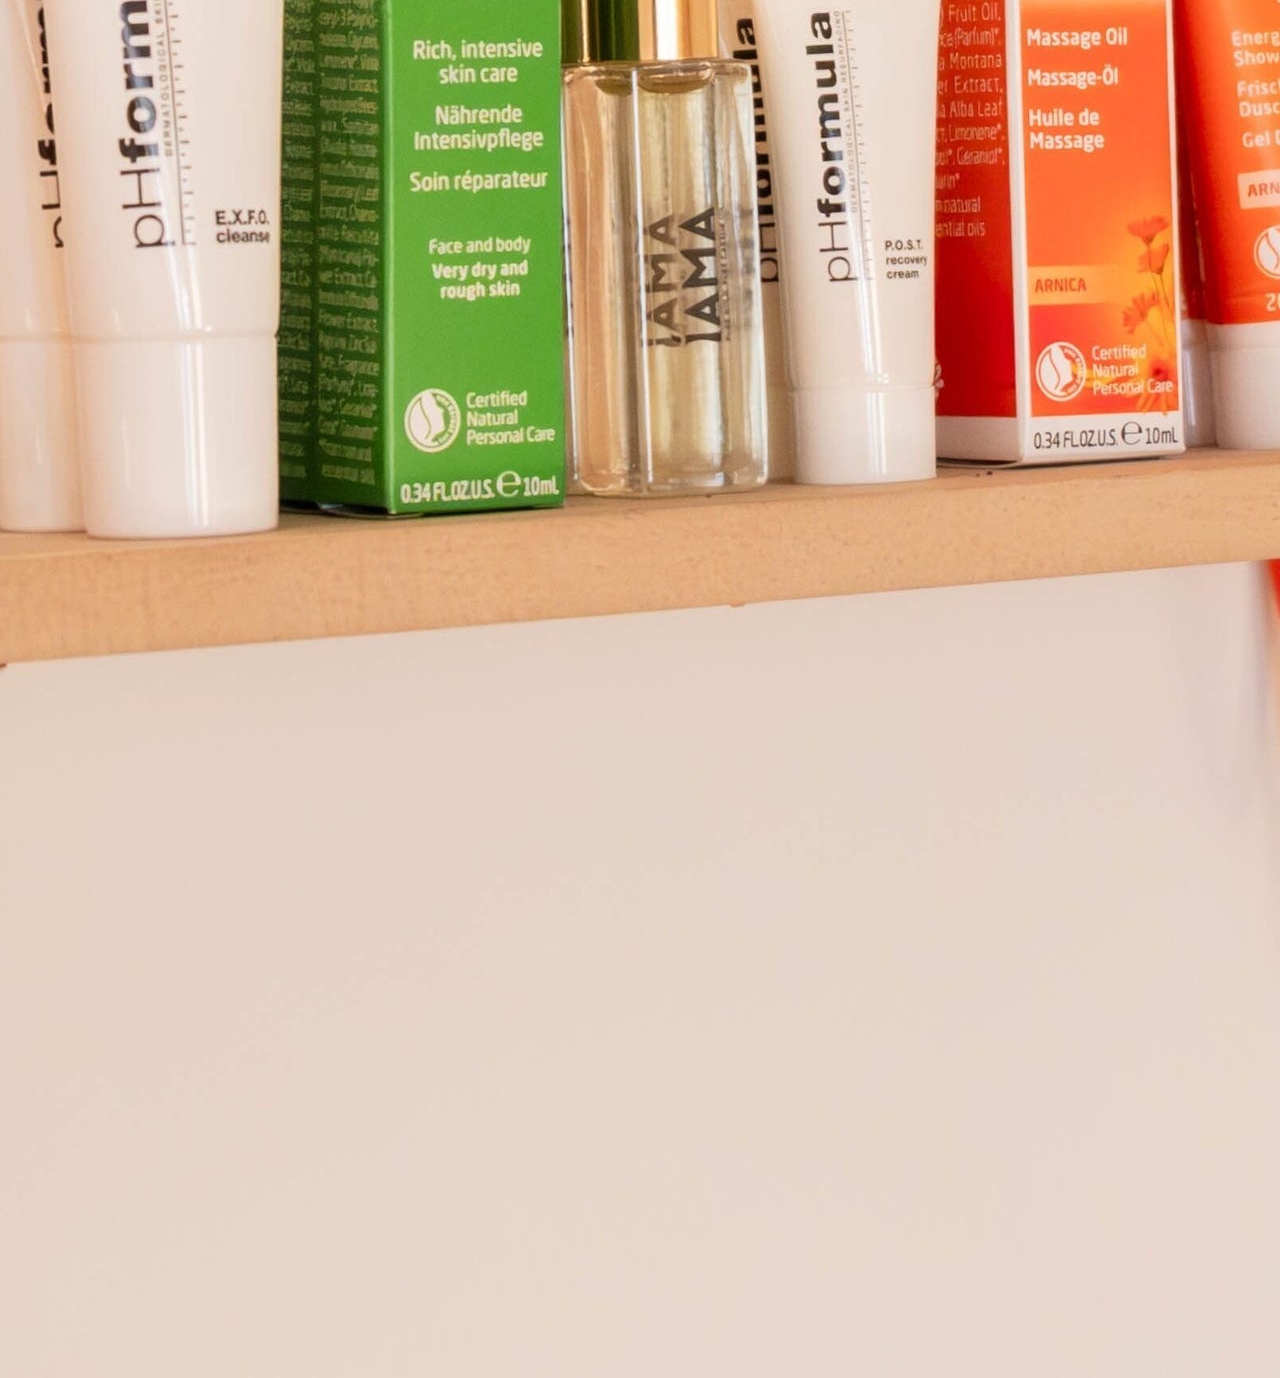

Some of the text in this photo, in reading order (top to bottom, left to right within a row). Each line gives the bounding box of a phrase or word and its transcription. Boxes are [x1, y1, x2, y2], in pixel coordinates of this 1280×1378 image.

[1027, 27, 1128, 50] Massage Oil
[413, 38, 543, 62] Rich, intensive
[949, 52, 1002, 70] Montana
[439, 64, 518, 84] skin care
[1028, 64, 1119, 88] Massage-Öl
[435, 105, 523, 126] Nährende
[1028, 108, 1100, 127] Huile de
[414, 129, 544, 152] Intensivpflege
[806, 11, 859, 282] pHformula
[1030, 131, 1105, 153] Massage
[1242, 130, 1270, 149] Gel
[410, 169, 548, 194] Soin réparateur
[216, 228, 270, 243] cleanse
[428, 236, 531, 255] Face and body
[432, 259, 528, 281] Very dry and
[885, 255, 928, 266] recovery
[886, 270, 920, 279] cream
[440, 281, 521, 302] rough skin
[1034, 277, 1087, 294] ARNICA
[1092, 344, 1147, 361] Certified
[1092, 362, 1139, 378] Natural
[1093, 378, 1174, 395] Personal Care
[466, 390, 528, 409] Certified
[467, 409, 519, 427] Natural
[467, 426, 556, 446] Personal Care
[1033, 431, 1061, 450] 0.34
[400, 483, 431, 504] 0.34
